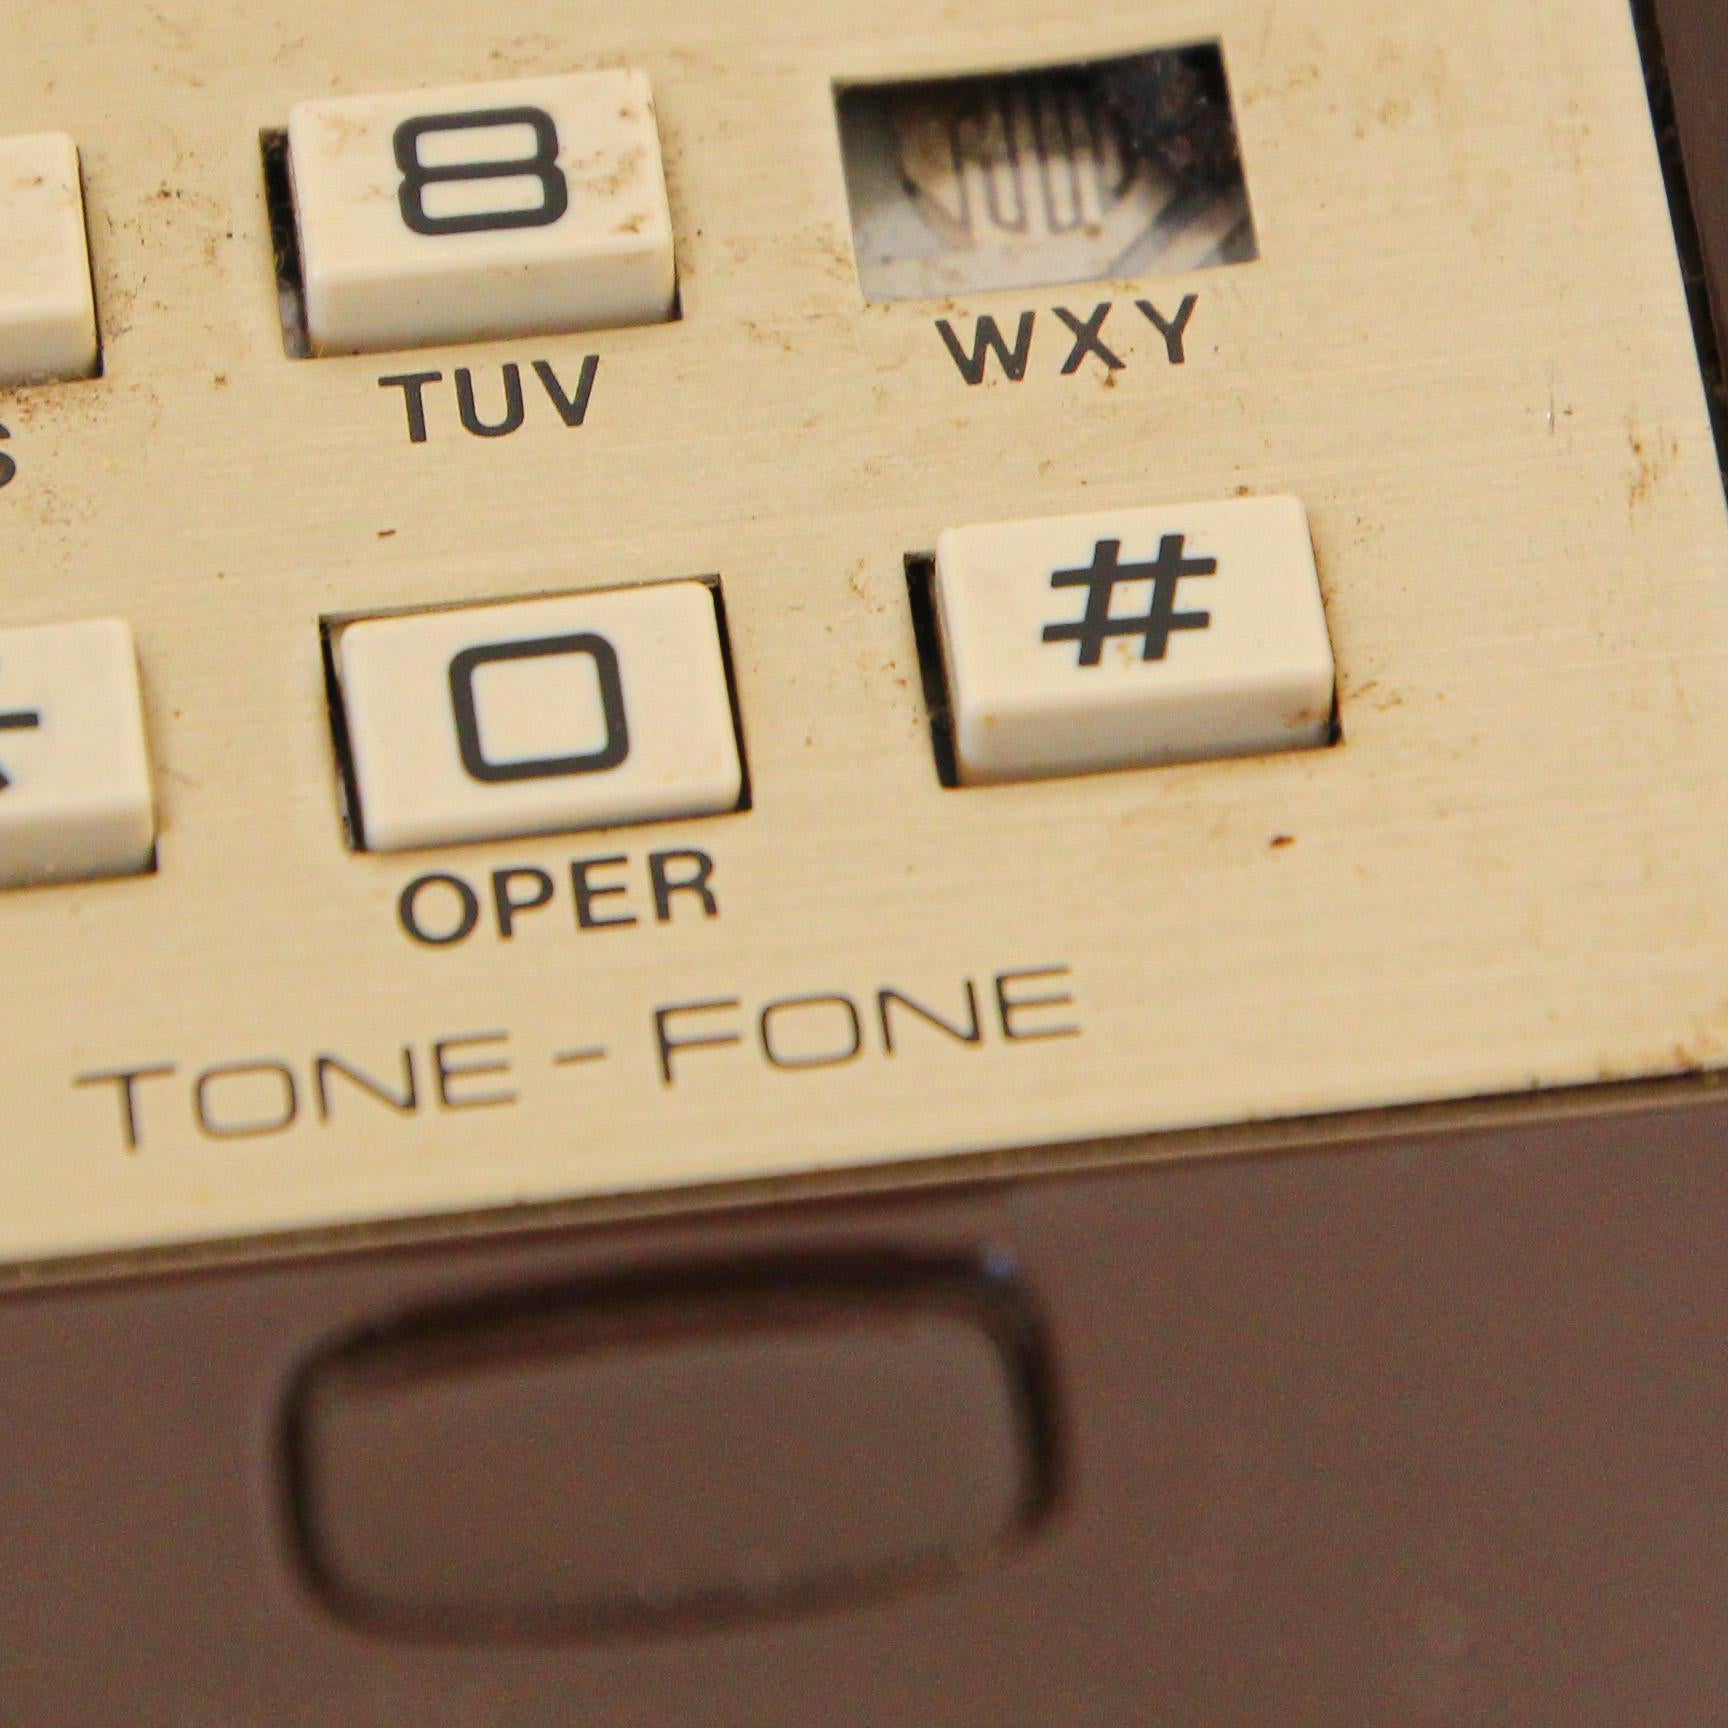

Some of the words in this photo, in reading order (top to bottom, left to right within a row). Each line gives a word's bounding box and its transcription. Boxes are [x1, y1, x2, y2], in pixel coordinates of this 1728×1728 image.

[392, 106, 569, 237] 8
[934, 294, 1198, 386] WXY
[377, 354, 600, 444] TUV
[1041, 533, 1218, 668] #
[394, 847, 722, 948] OPER
